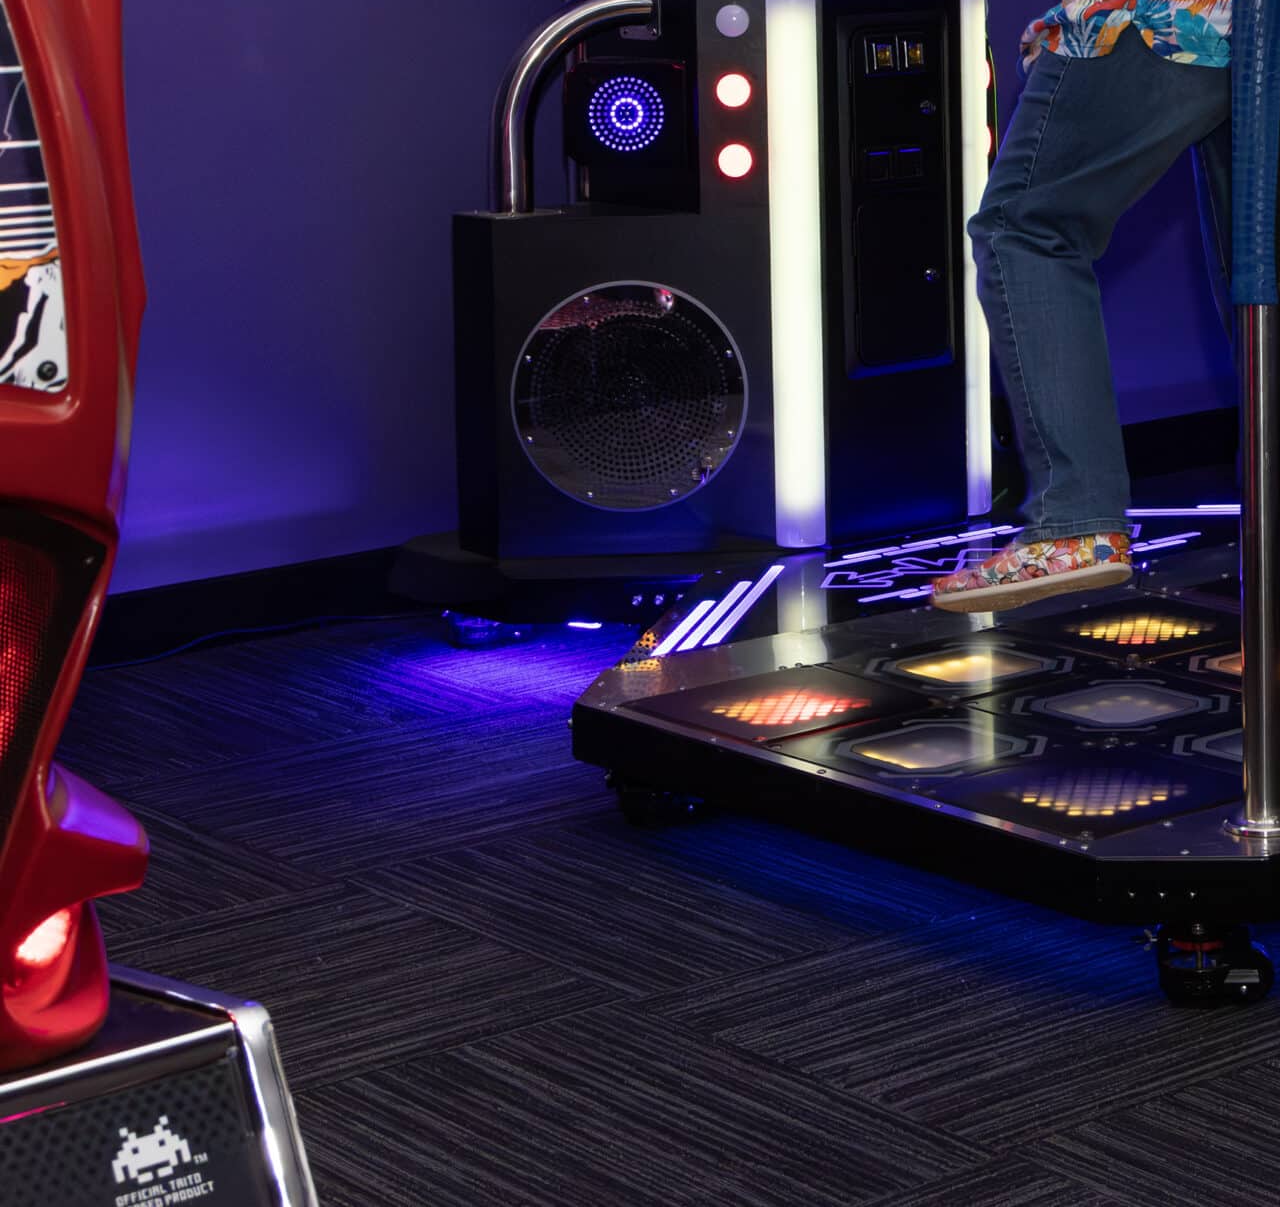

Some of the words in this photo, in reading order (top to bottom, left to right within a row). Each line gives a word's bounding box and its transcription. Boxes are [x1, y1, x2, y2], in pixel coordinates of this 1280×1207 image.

[193, 1152, 208, 1165] TM
[115, 1184, 167, 1207] OFFICIAL
[168, 1172, 202, 1191] TAITO
[164, 1180, 214, 1205] PRODUCT
